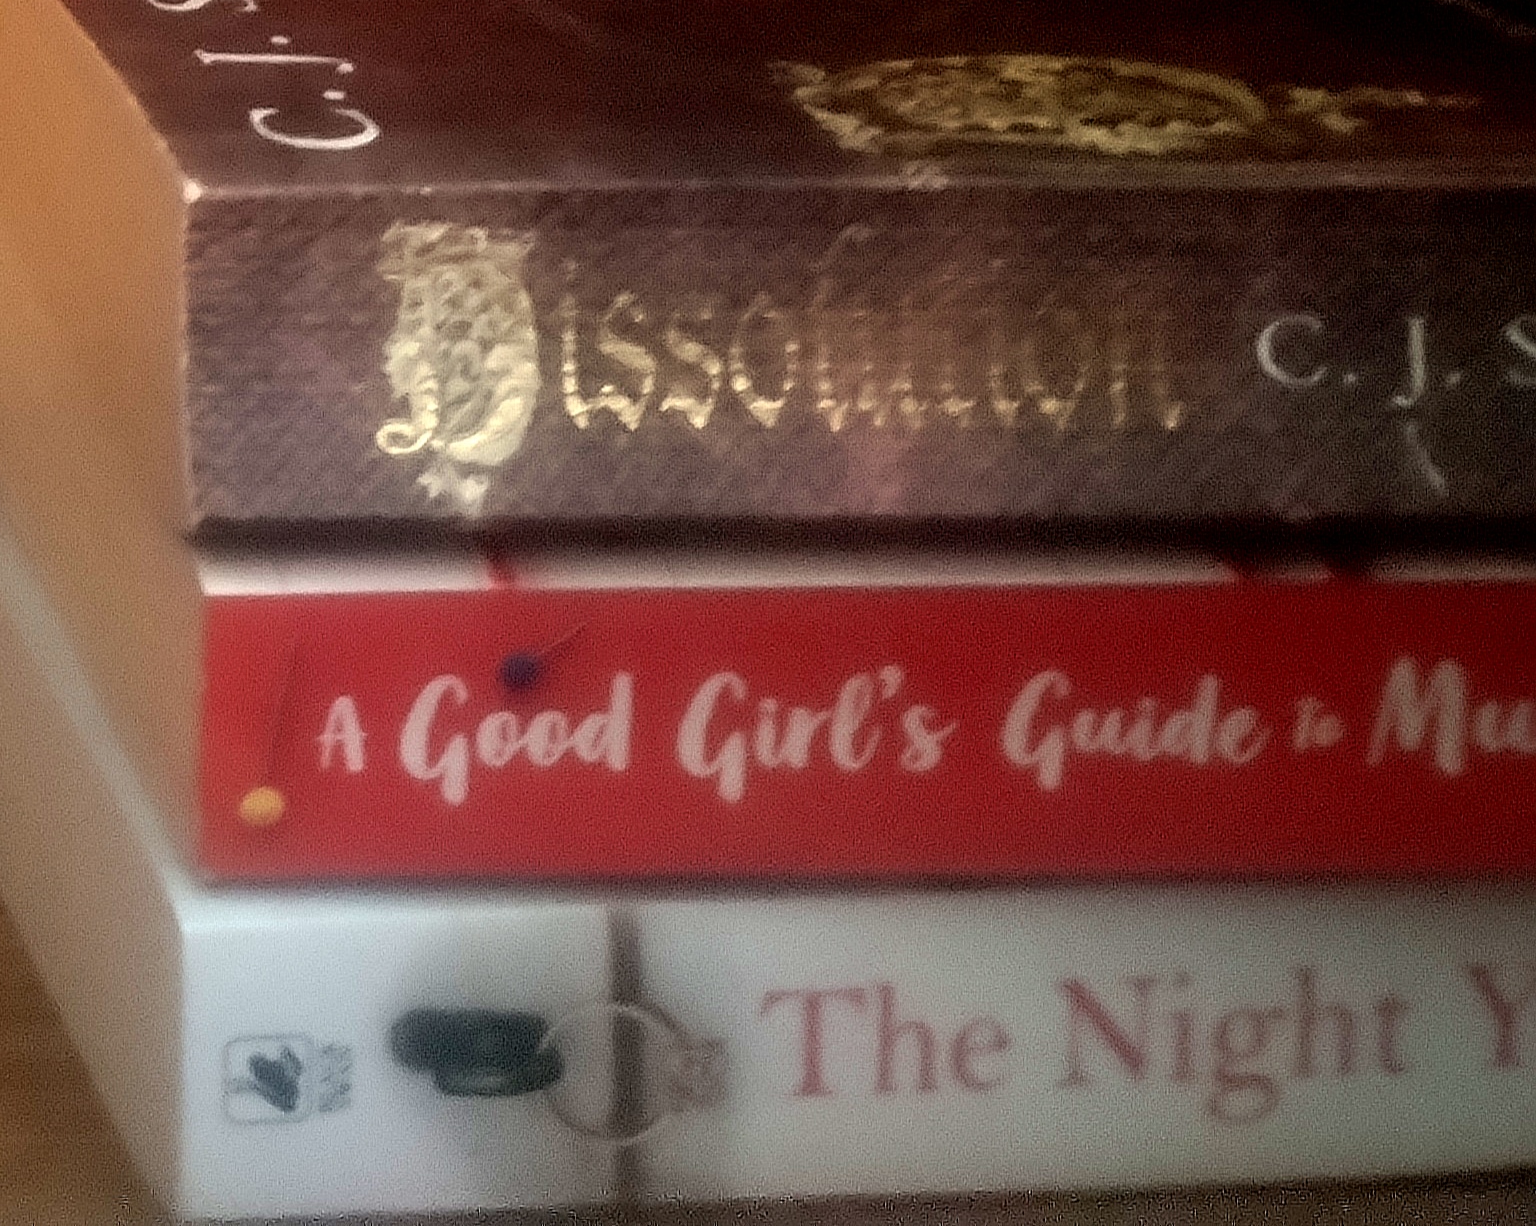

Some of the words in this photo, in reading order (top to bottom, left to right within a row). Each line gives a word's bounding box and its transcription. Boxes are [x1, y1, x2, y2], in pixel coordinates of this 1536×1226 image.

[1256, 313, 1358, 387] C.
[317, 693, 368, 773] A
[399, 671, 635, 807] Good
[676, 663, 957, 803] Girl's
[1000, 669, 1273, 792] Guide
[1291, 695, 1345, 754] to
[759, 981, 1013, 1099] The
[1057, 963, 1413, 1128] Night
